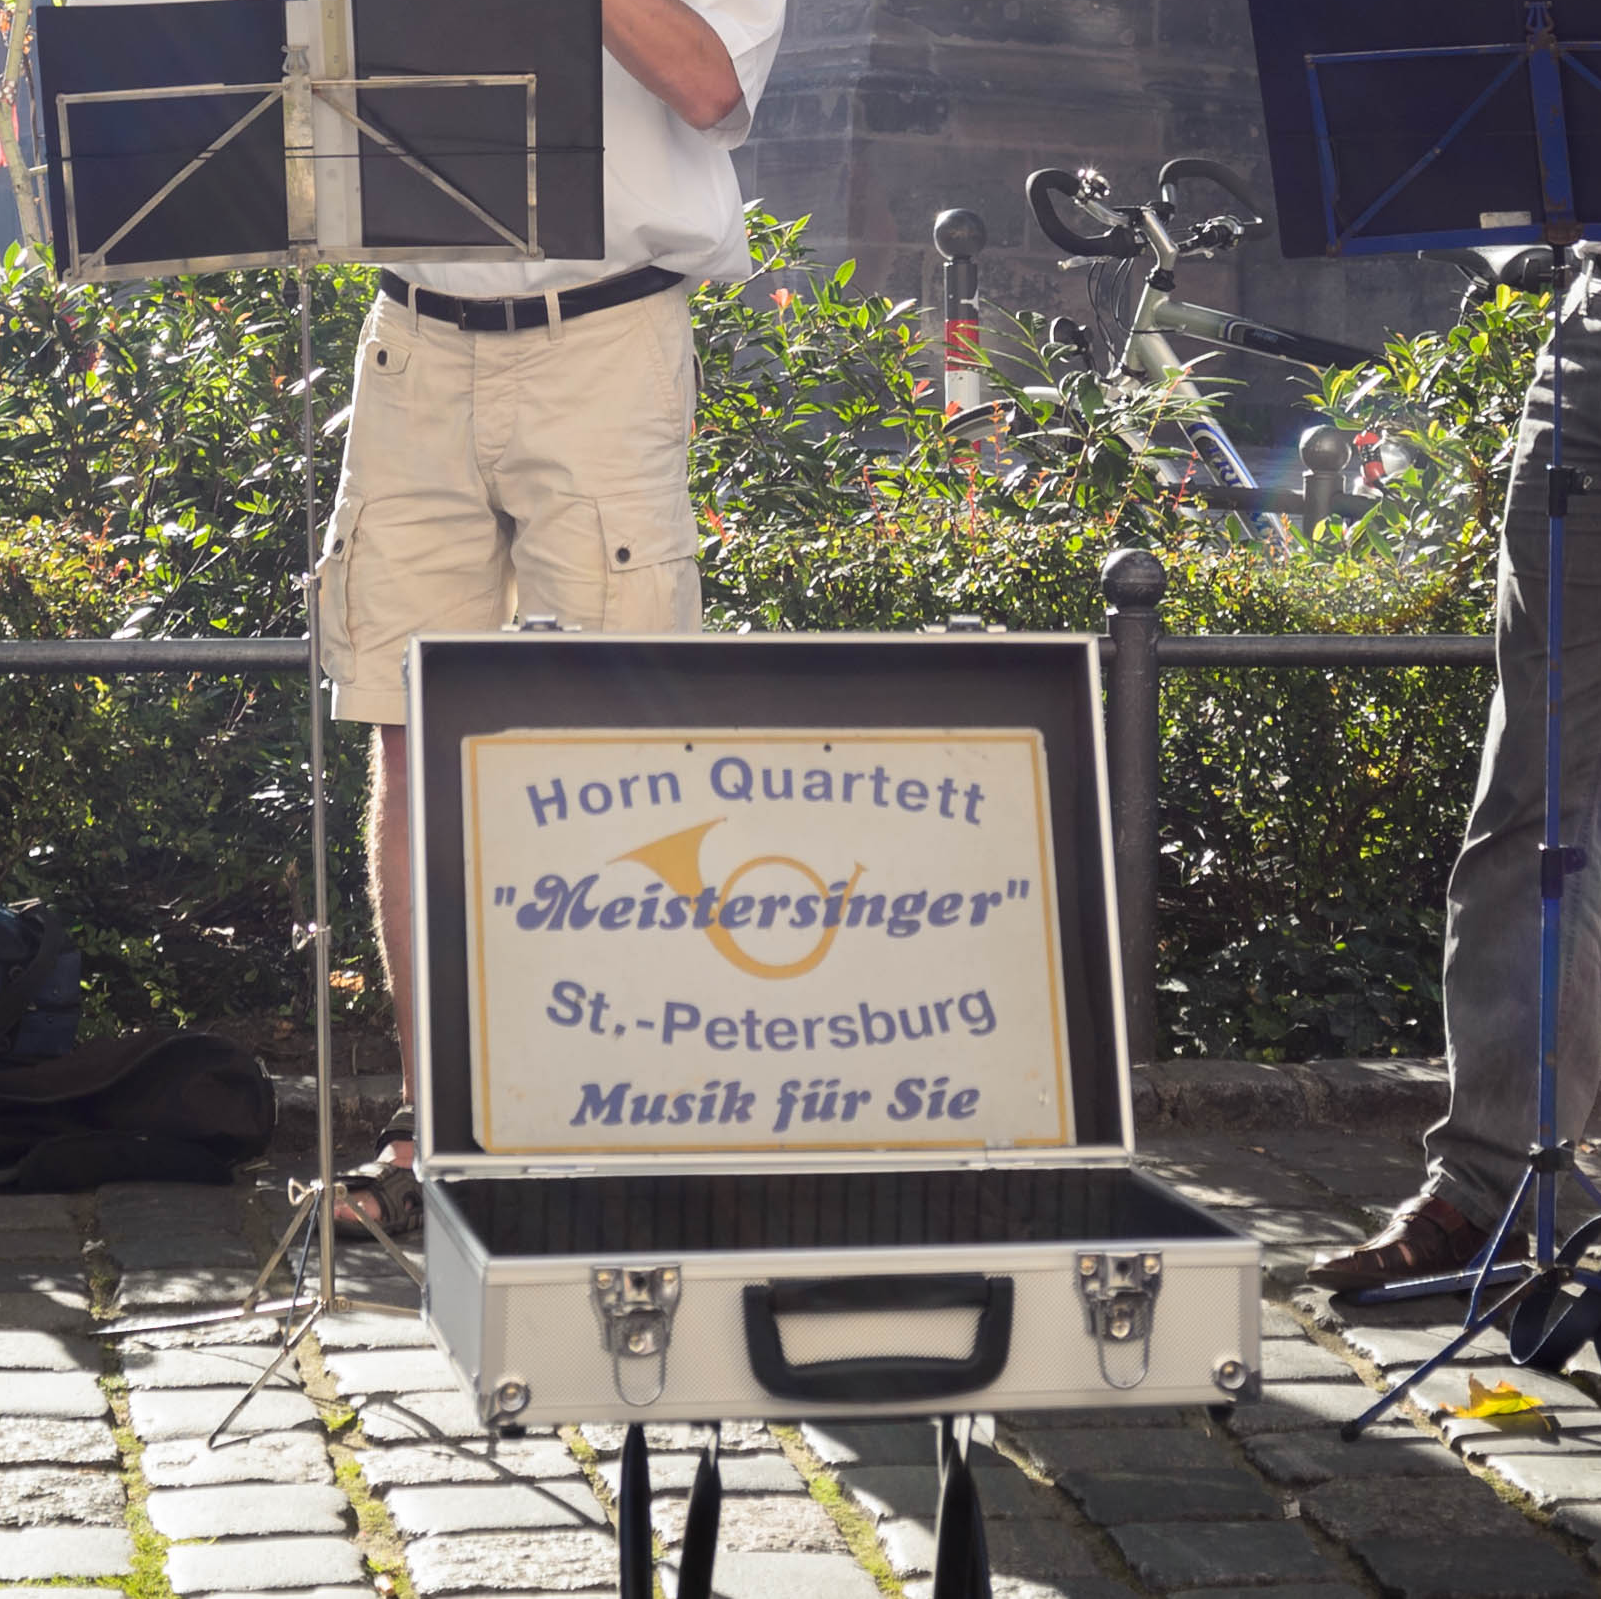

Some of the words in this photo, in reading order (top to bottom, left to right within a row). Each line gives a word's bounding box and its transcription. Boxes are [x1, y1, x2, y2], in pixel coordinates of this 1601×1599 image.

[525, 772, 683, 828] Horn
[710, 756, 986, 826] Quartett
[546, 980, 998, 1052] St.-Petersburg
[569, 1081, 756, 1127] Musik
[772, 1080, 872, 1133] für
[887, 1077, 981, 1121] Sie
